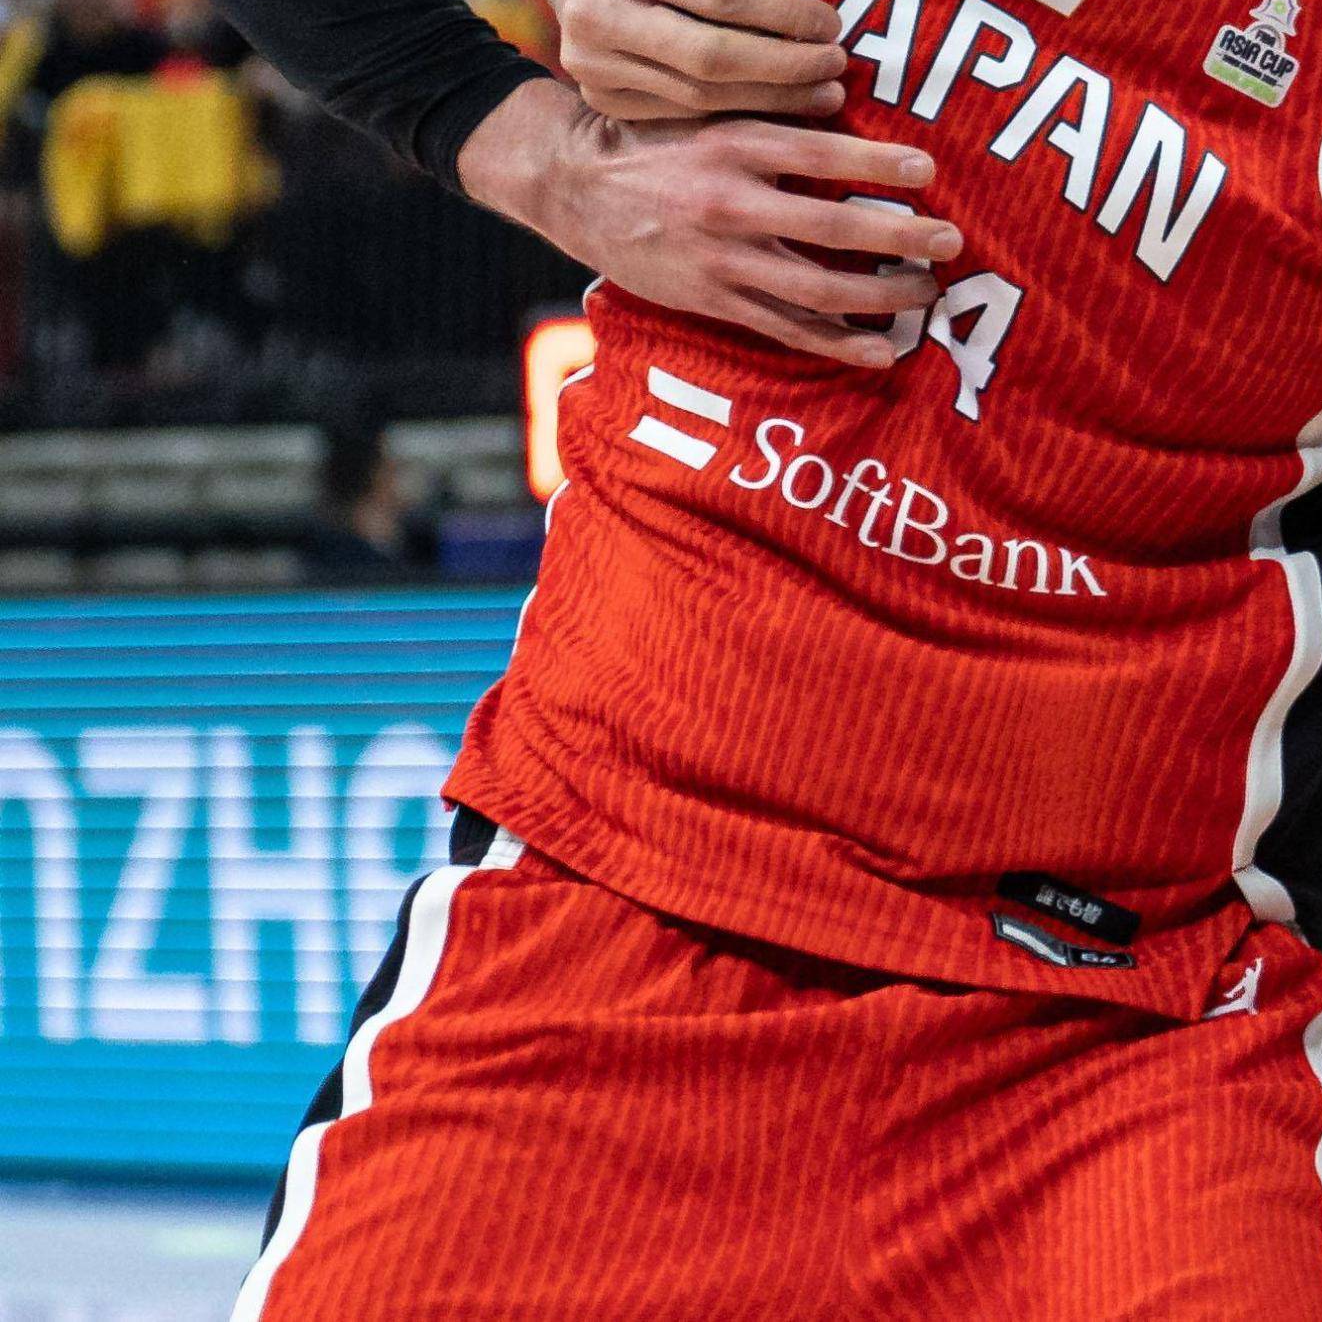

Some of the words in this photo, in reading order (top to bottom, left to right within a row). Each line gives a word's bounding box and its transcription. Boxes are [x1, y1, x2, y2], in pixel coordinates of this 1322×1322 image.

[1220, 30, 1261, 64] ASIA
[1260, 50, 1295, 78] CUP
[729, 417, 1107, 599] SoftBank
